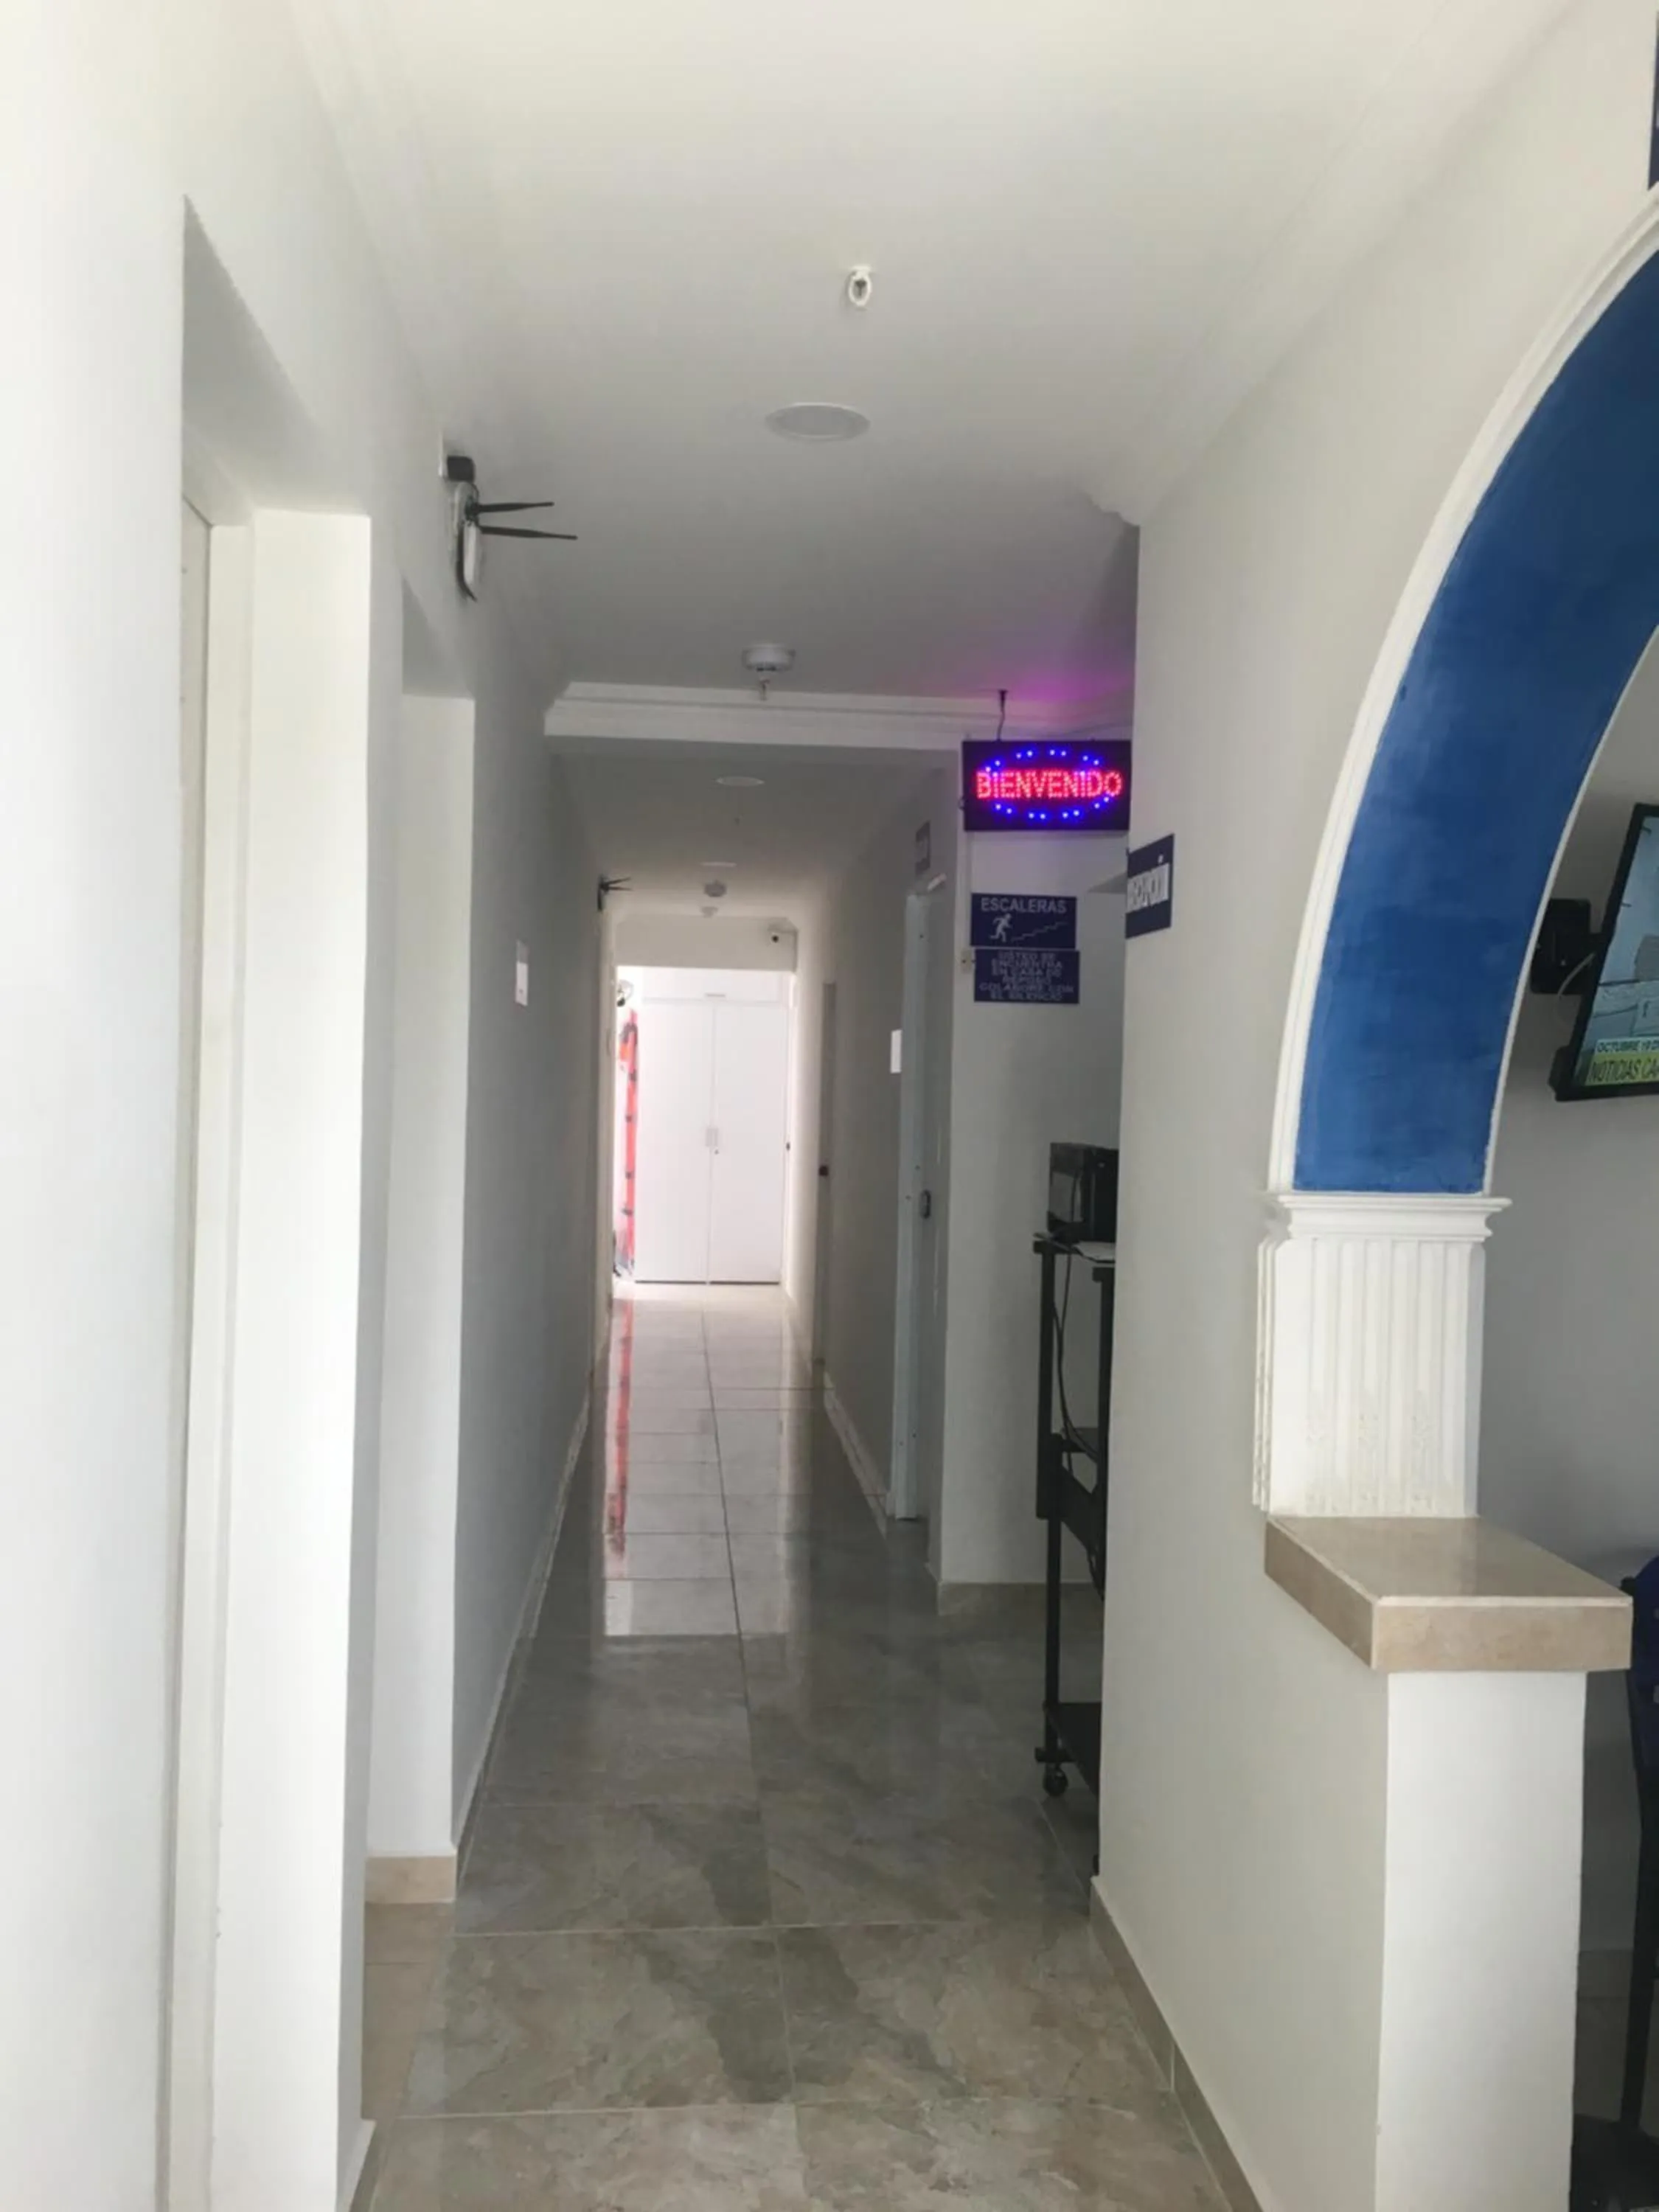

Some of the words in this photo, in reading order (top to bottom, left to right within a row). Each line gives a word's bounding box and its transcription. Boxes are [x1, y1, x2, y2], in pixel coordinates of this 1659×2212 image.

[976, 771, 1122, 799] BIENVENIDO
[981, 897, 1067, 914] ESCALERAS
[1590, 1058, 1642, 1084] NOTICIAS
